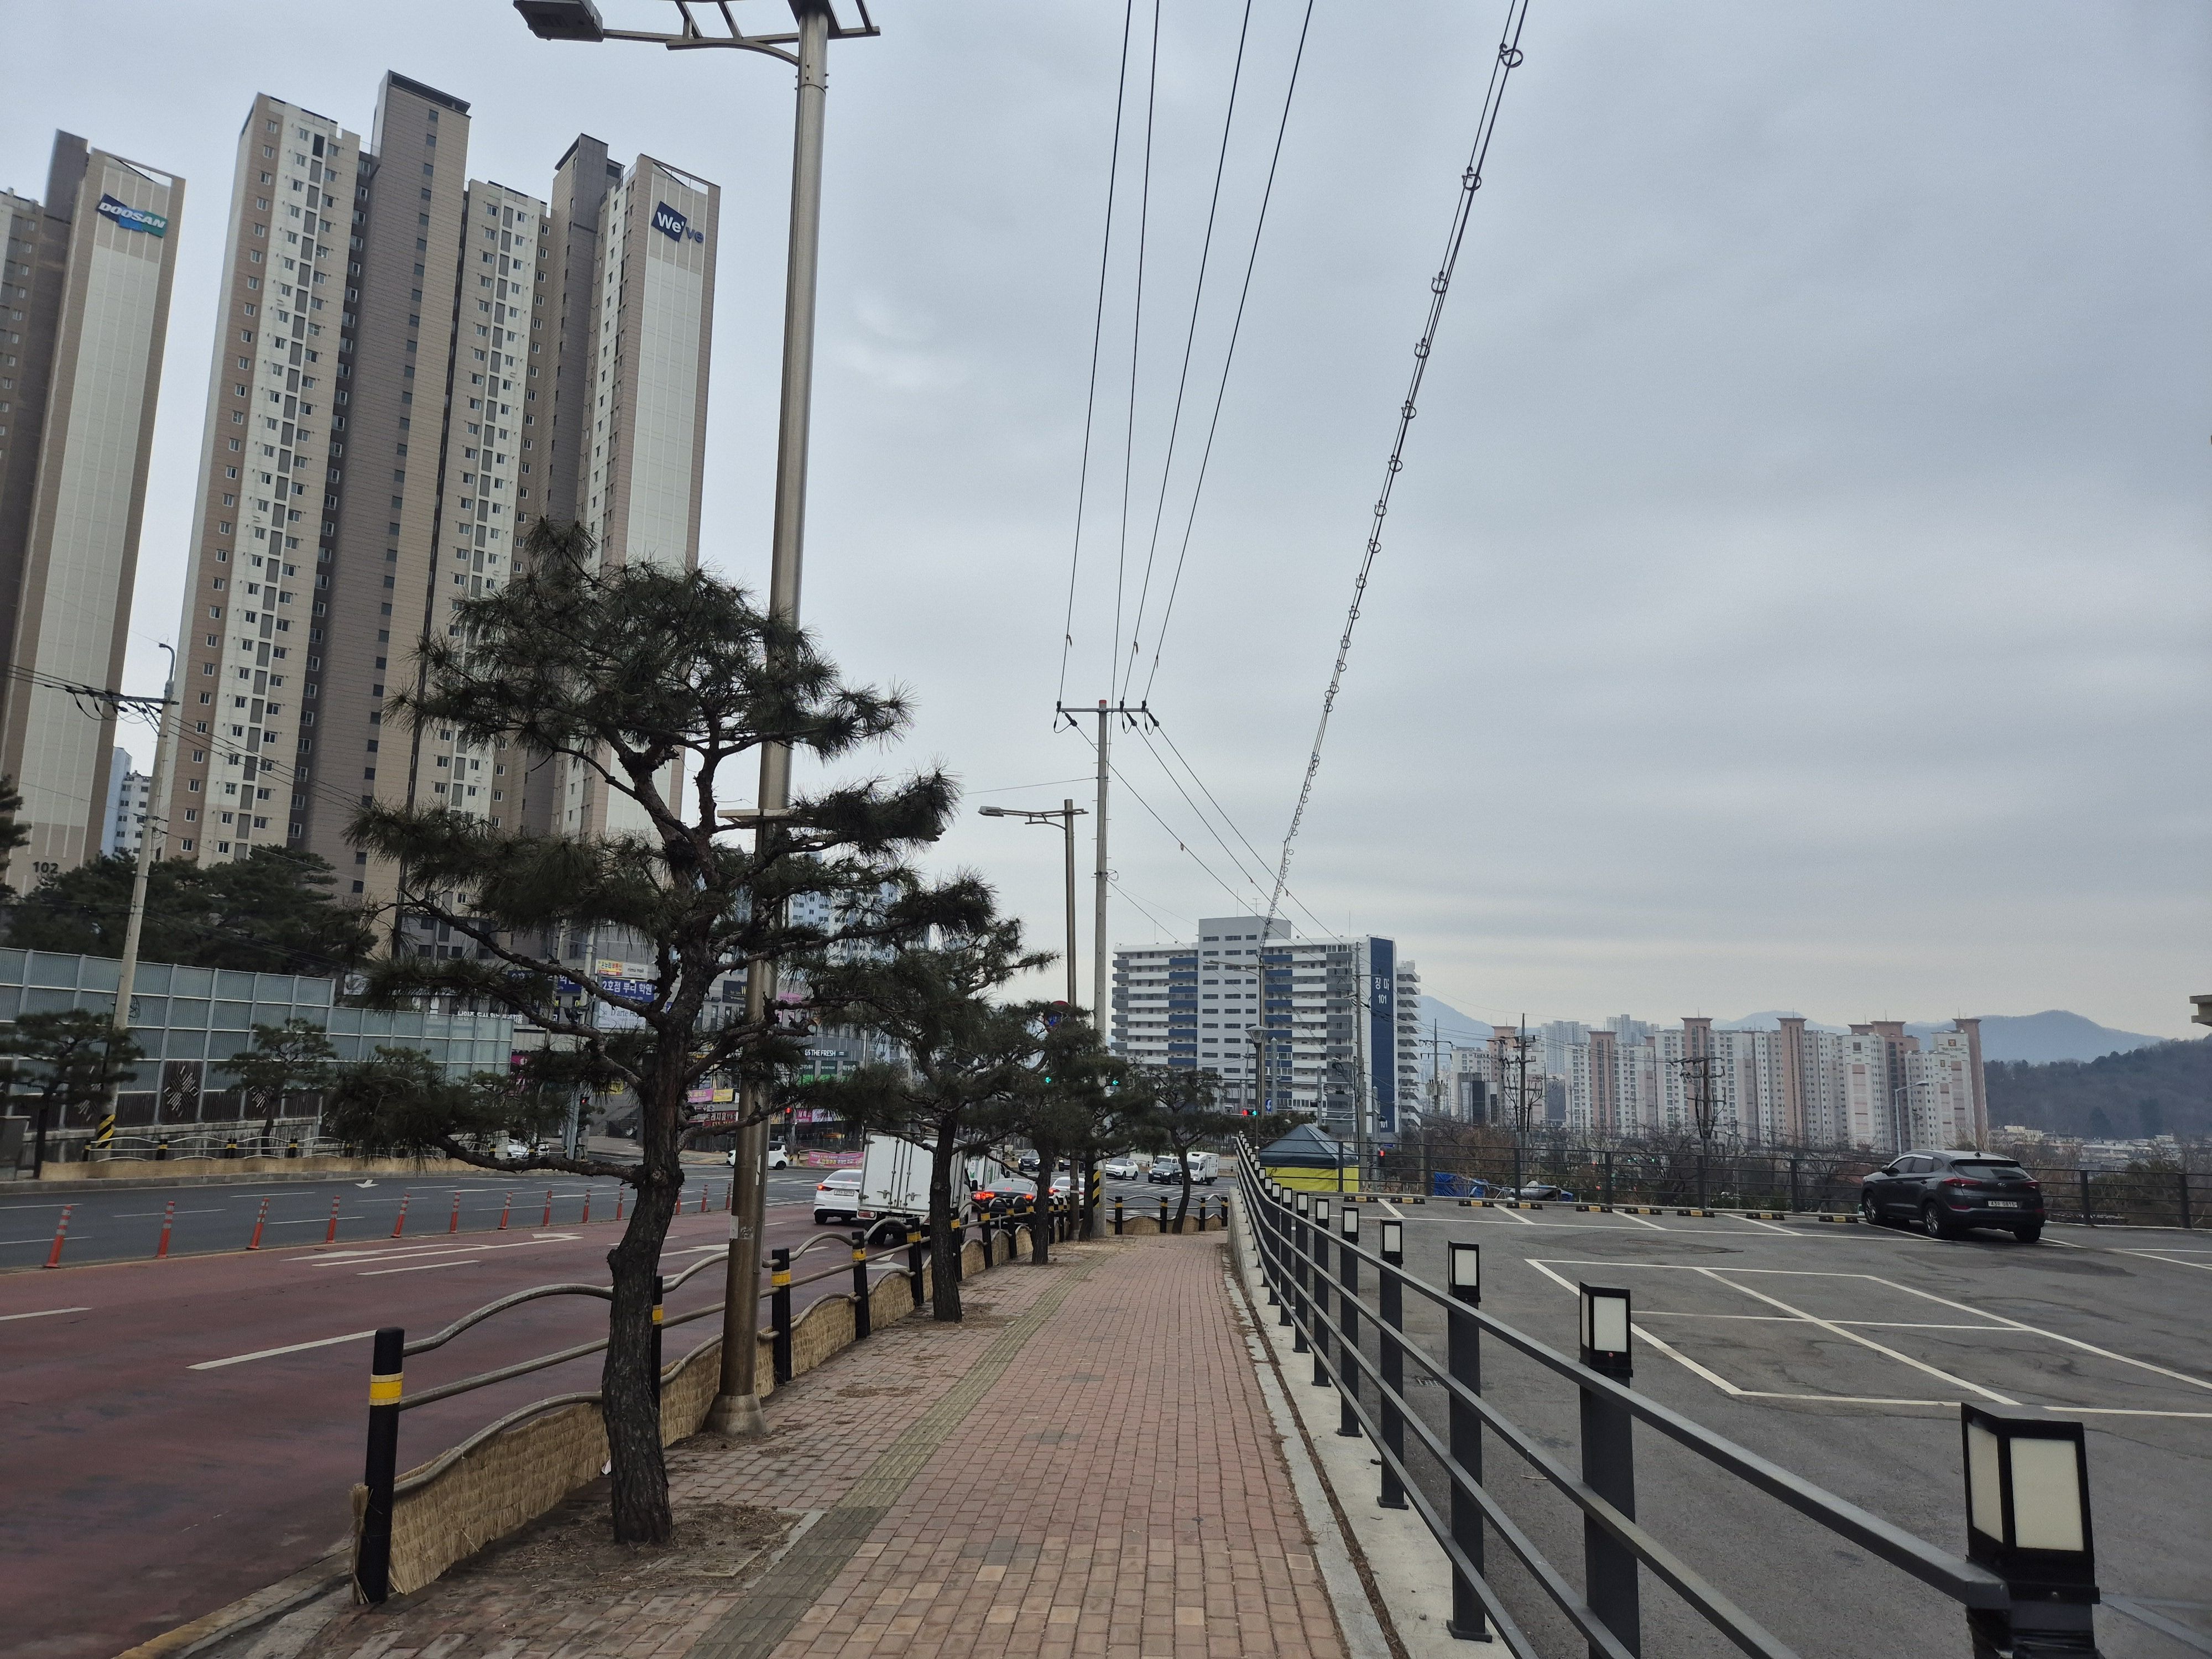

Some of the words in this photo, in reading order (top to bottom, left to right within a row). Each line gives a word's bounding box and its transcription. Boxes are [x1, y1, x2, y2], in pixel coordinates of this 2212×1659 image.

[98, 202, 166, 228] DOOSAN
[33, 861, 59, 874] 102
[602, 980, 620, 993] 2호점
[639, 983, 652, 995] 학원
[1378, 994, 1387, 1004] 101
[706, 1112, 726, 1121] 트레지움
